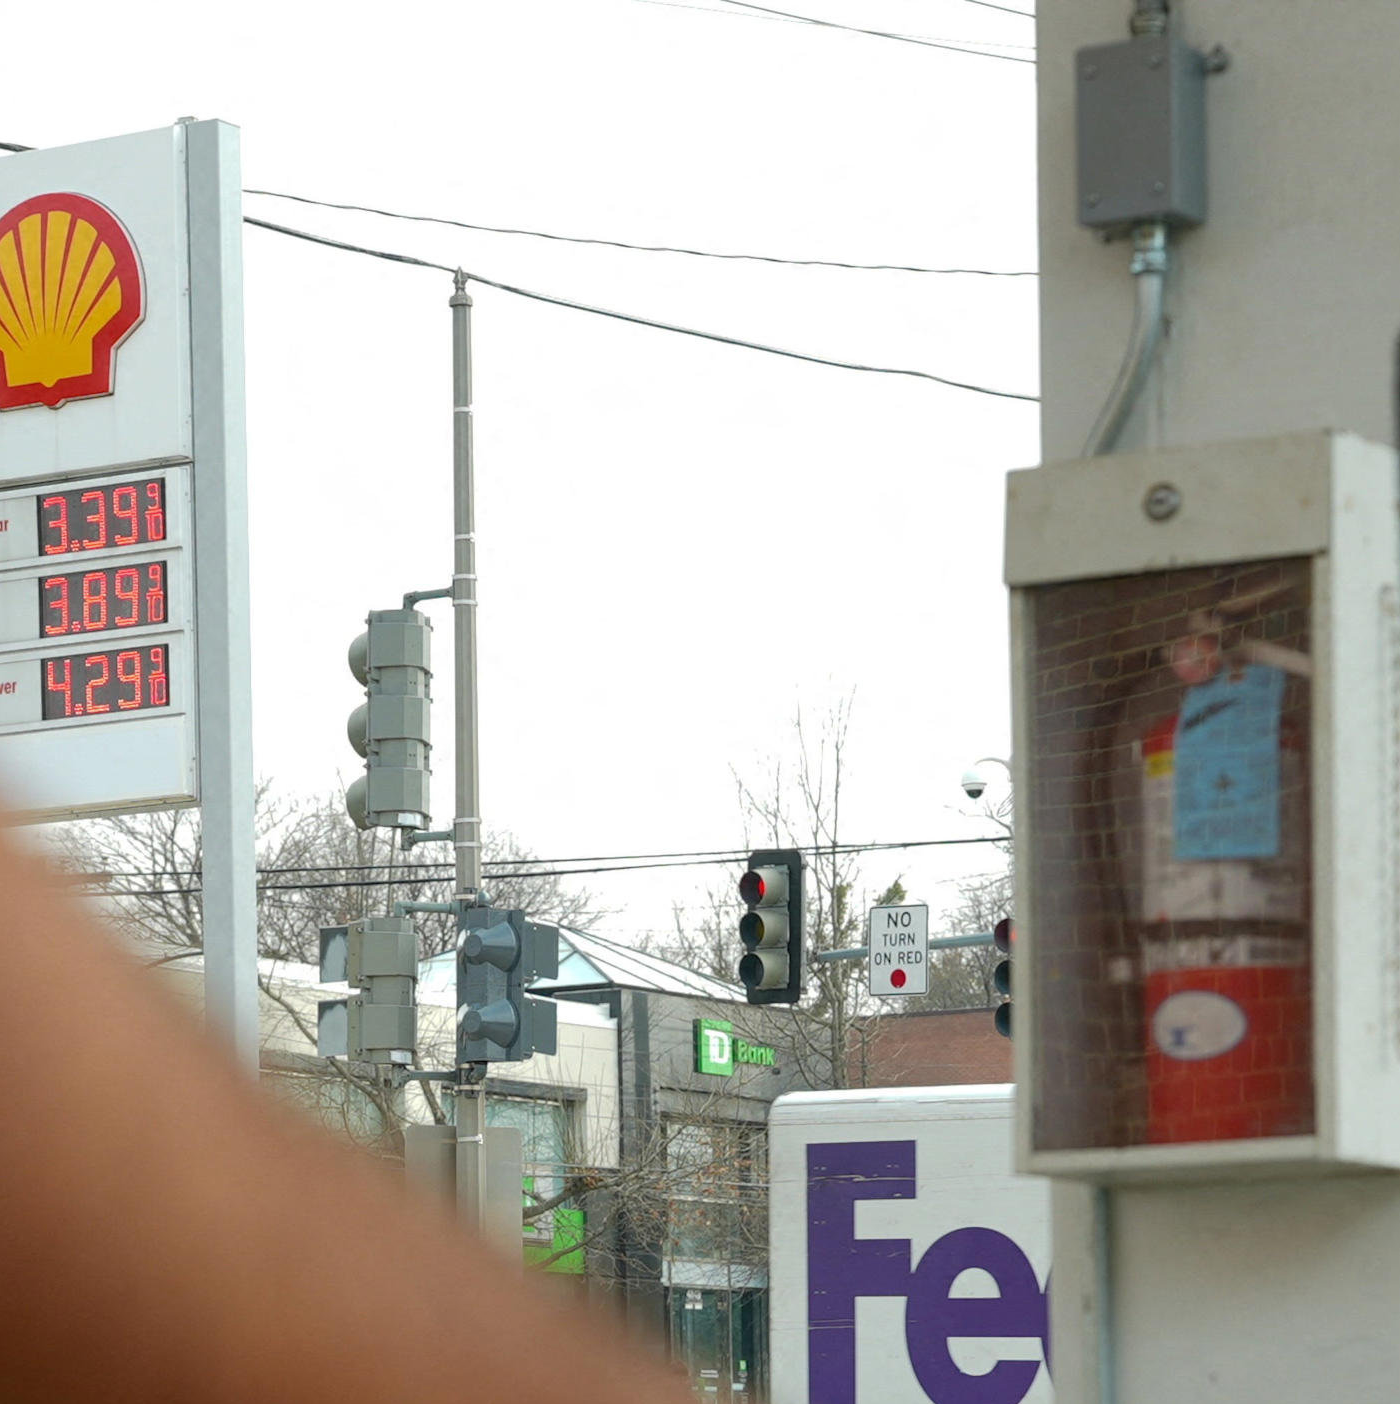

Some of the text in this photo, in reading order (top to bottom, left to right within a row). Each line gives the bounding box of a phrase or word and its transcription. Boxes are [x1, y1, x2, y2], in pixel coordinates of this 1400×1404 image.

[43, 486, 137, 555] 3.39
[45, 568, 140, 635] 3.89
[47, 651, 142, 716] 4.29
[887, 911, 911, 929] NO
[882, 932, 916, 947] TURN
[874, 951, 923, 967] ON RED
[704, 1029, 776, 1067] TD Bank
